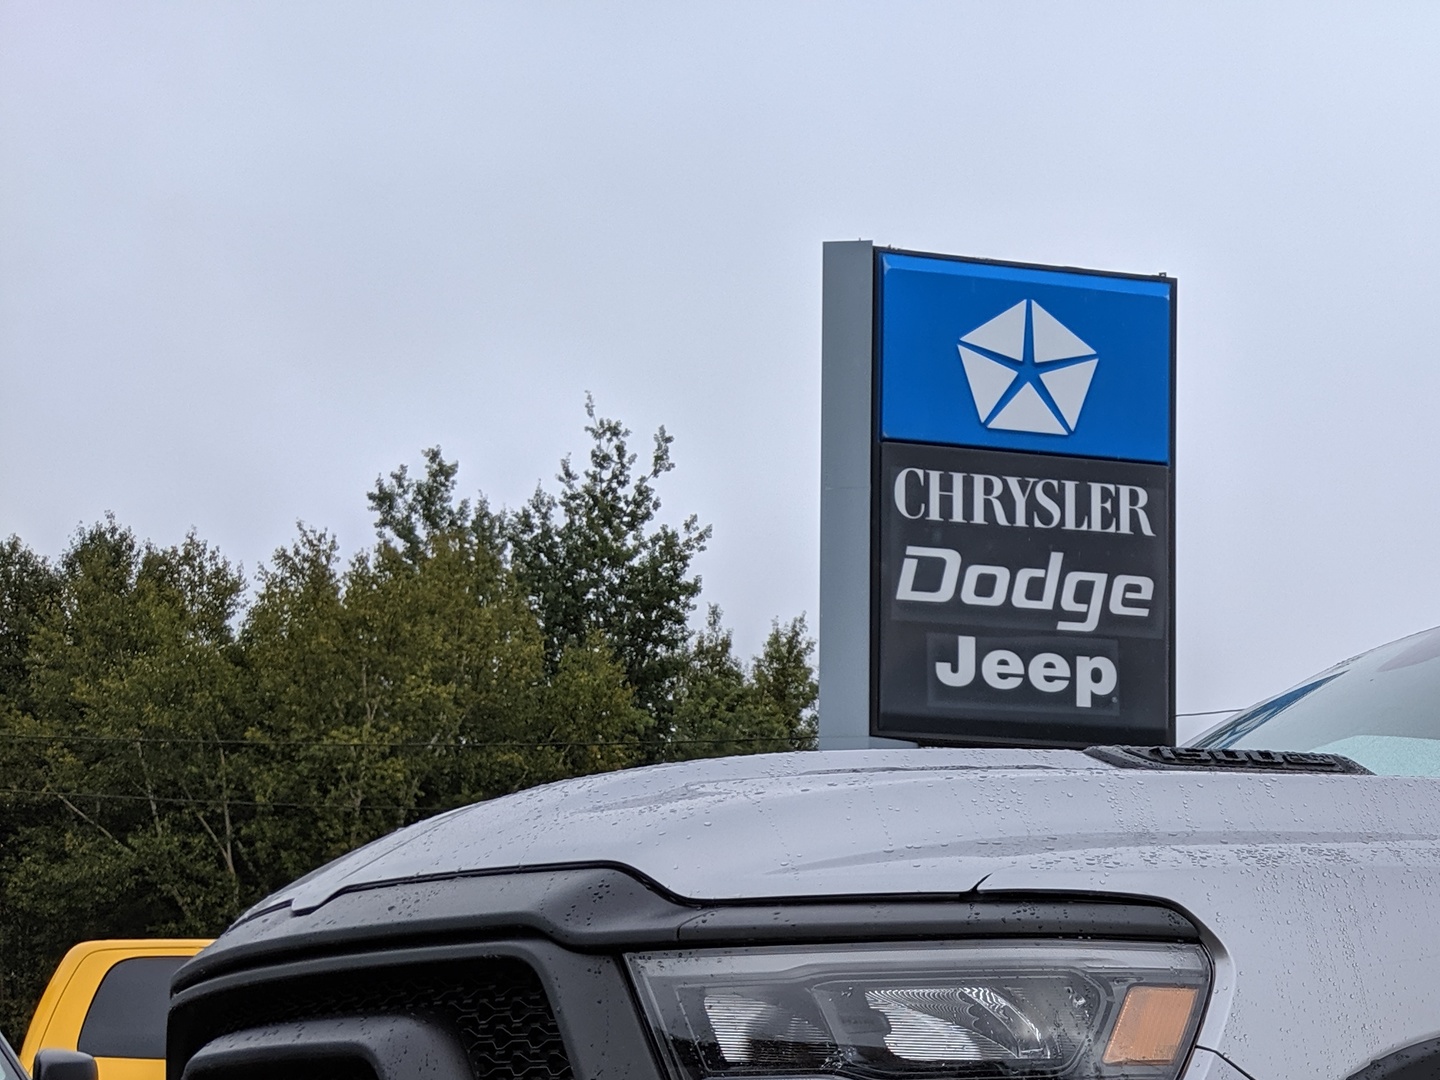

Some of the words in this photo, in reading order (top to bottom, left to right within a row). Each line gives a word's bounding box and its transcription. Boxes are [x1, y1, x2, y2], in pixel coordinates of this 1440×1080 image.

[893, 466, 1157, 537] CHRYSLER
[895, 545, 1155, 632] Dodge
[935, 635, 1118, 708] Jeep
